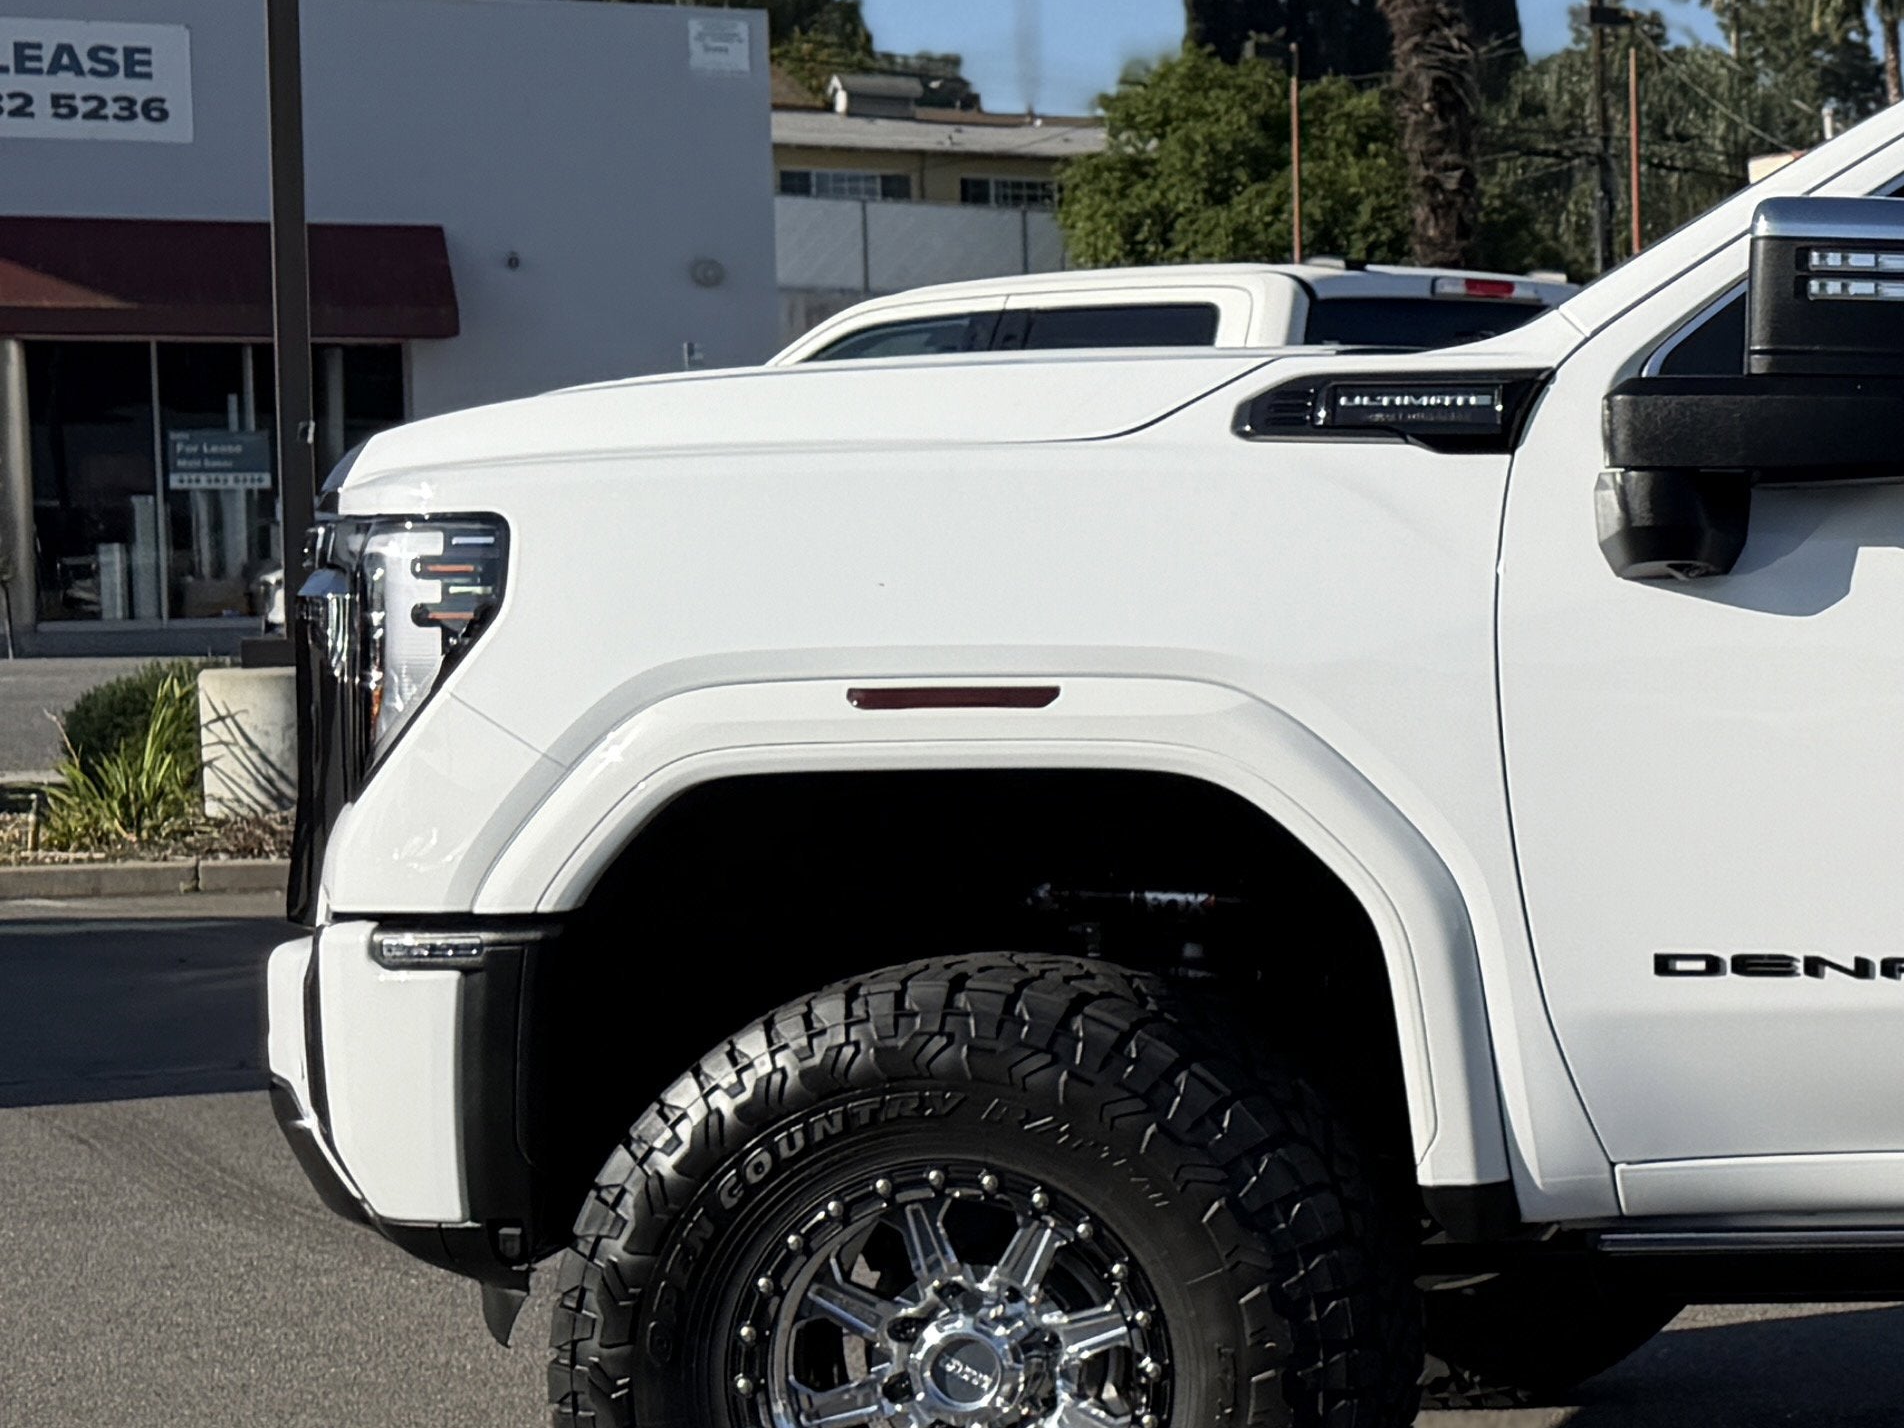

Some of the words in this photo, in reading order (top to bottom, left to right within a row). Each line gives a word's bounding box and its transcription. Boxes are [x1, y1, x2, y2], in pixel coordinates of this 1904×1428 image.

[0, 91, 35, 119] 2
[50, 93, 169, 123] 5236
[719, 1090, 967, 1211] COUNTRY
